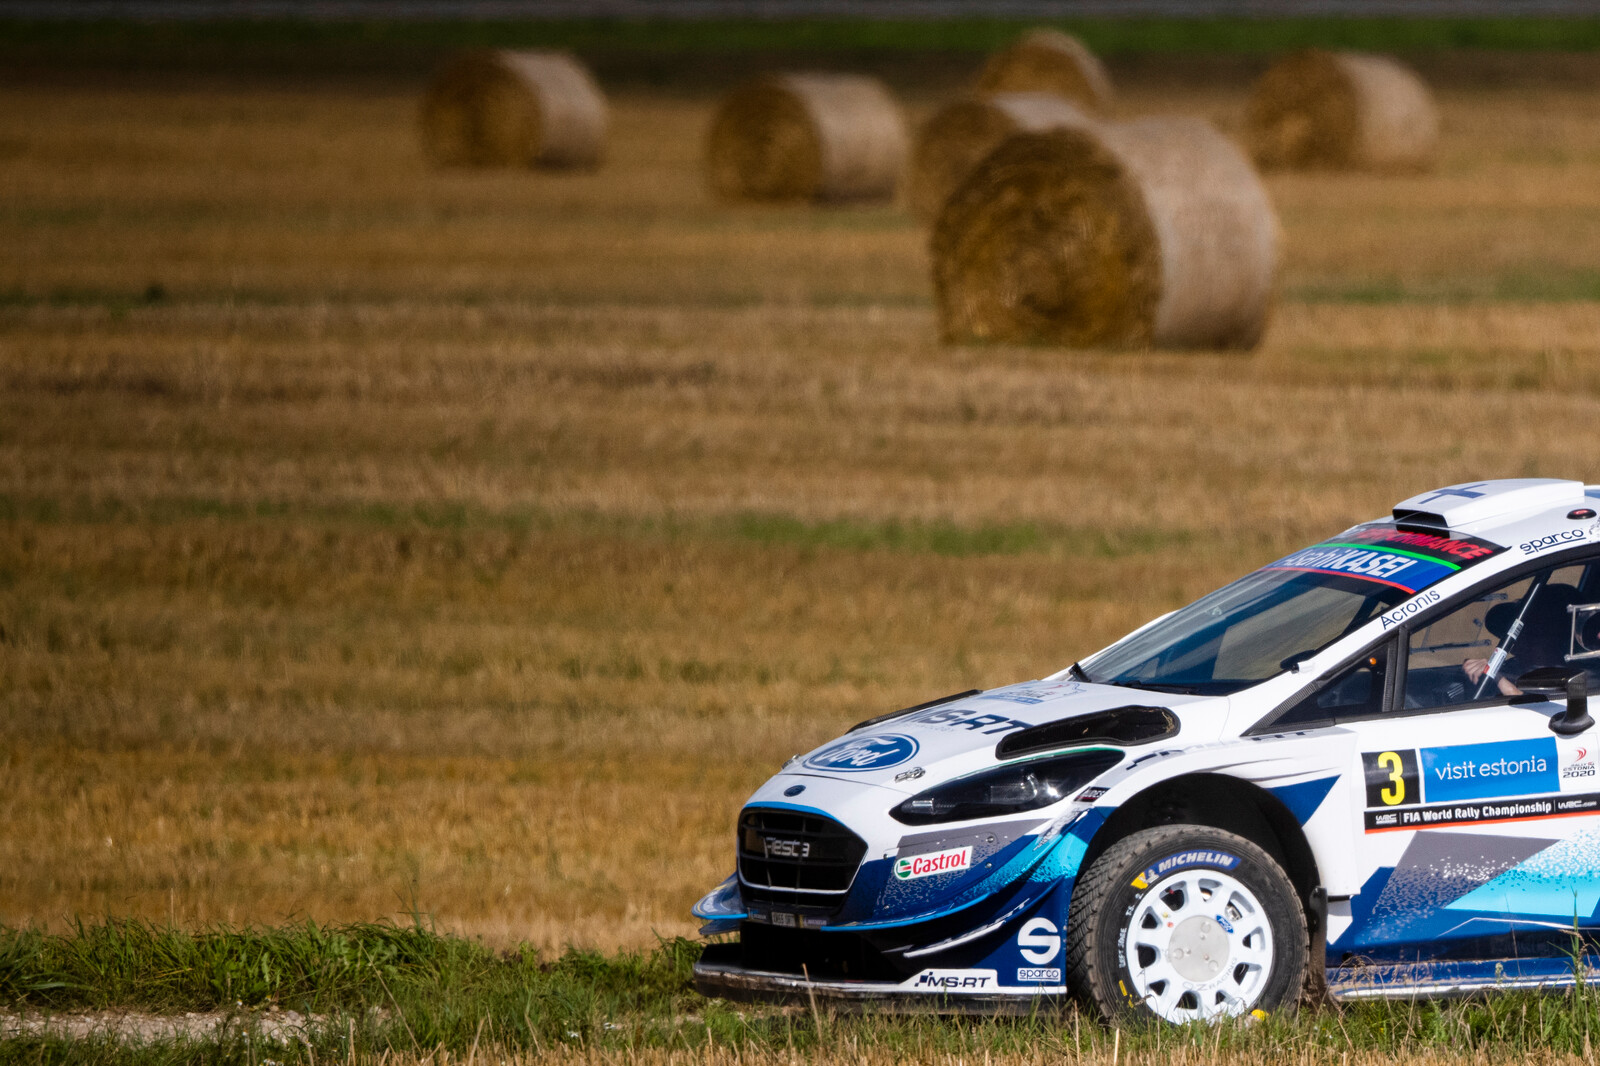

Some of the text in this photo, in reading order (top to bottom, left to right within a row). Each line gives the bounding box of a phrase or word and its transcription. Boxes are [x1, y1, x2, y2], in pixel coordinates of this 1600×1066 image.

[1519, 528, 1585, 554] sparco
[1379, 589, 1441, 631] Acronis
[813, 736, 901, 767] Ford
[1378, 751, 1405, 806] 3
[1435, 755, 1547, 781] visit estonia
[1563, 770, 1596, 778] 2020
[1403, 801, 1552, 823] FIA World Rally Championship
[913, 850, 966, 875] Castrol
[1158, 851, 1234, 873] MICHELIN
[928, 976, 991, 988] MS-RT
[1019, 969, 1059, 979] sparco
